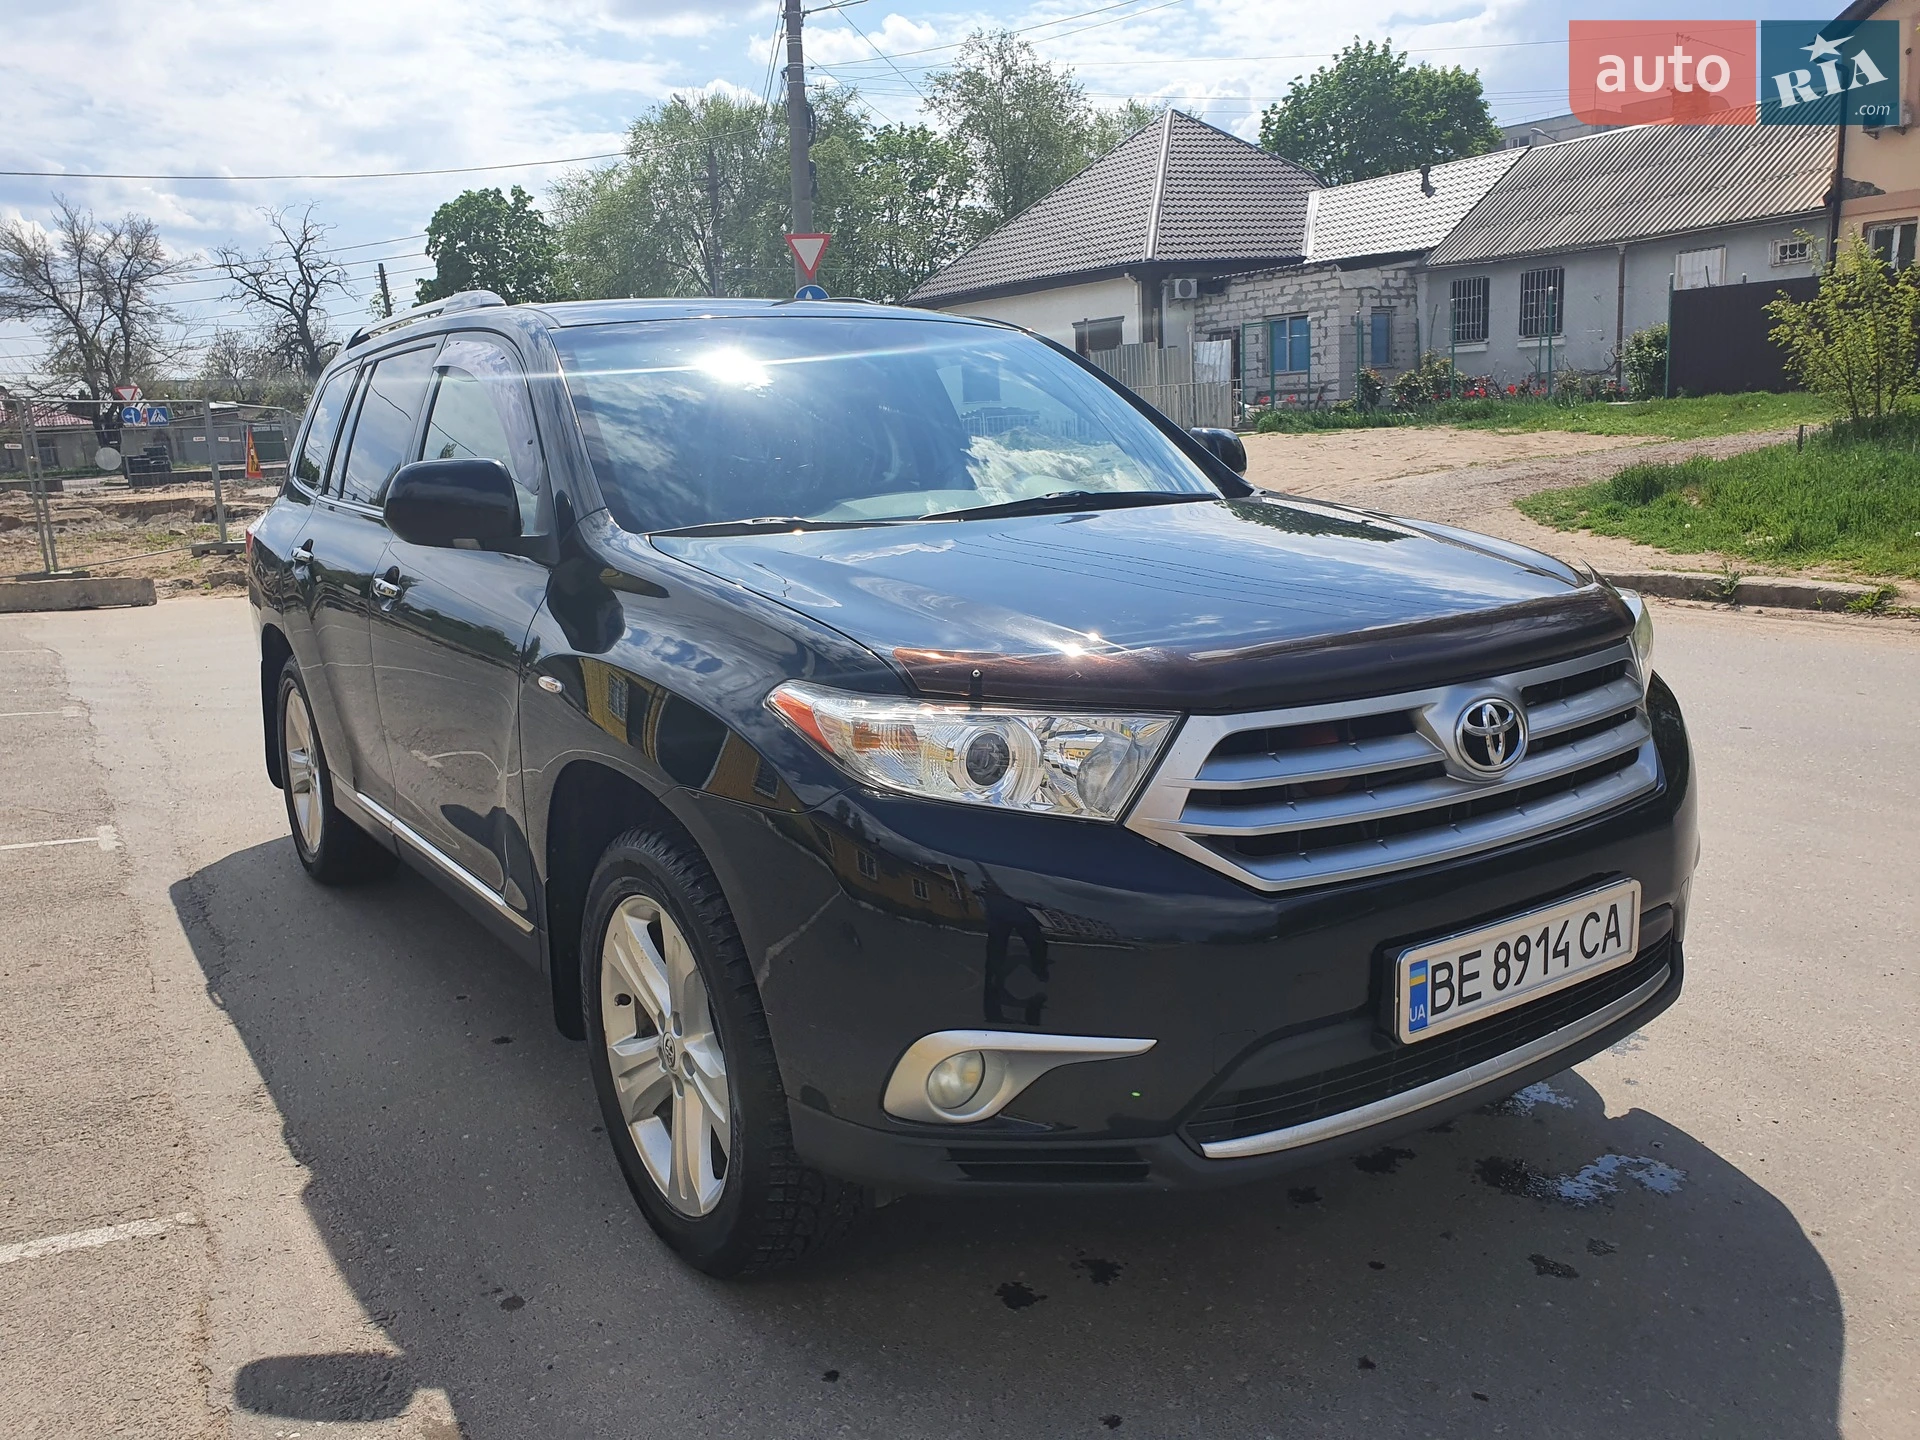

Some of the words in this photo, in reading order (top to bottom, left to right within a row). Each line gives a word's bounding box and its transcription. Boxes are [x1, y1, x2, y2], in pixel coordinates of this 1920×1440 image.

[1430, 950, 1482, 1016] BE
[1493, 920, 1569, 991] 8914
[1579, 904, 1621, 959] CA
[1409, 1003, 1426, 1022] UA
